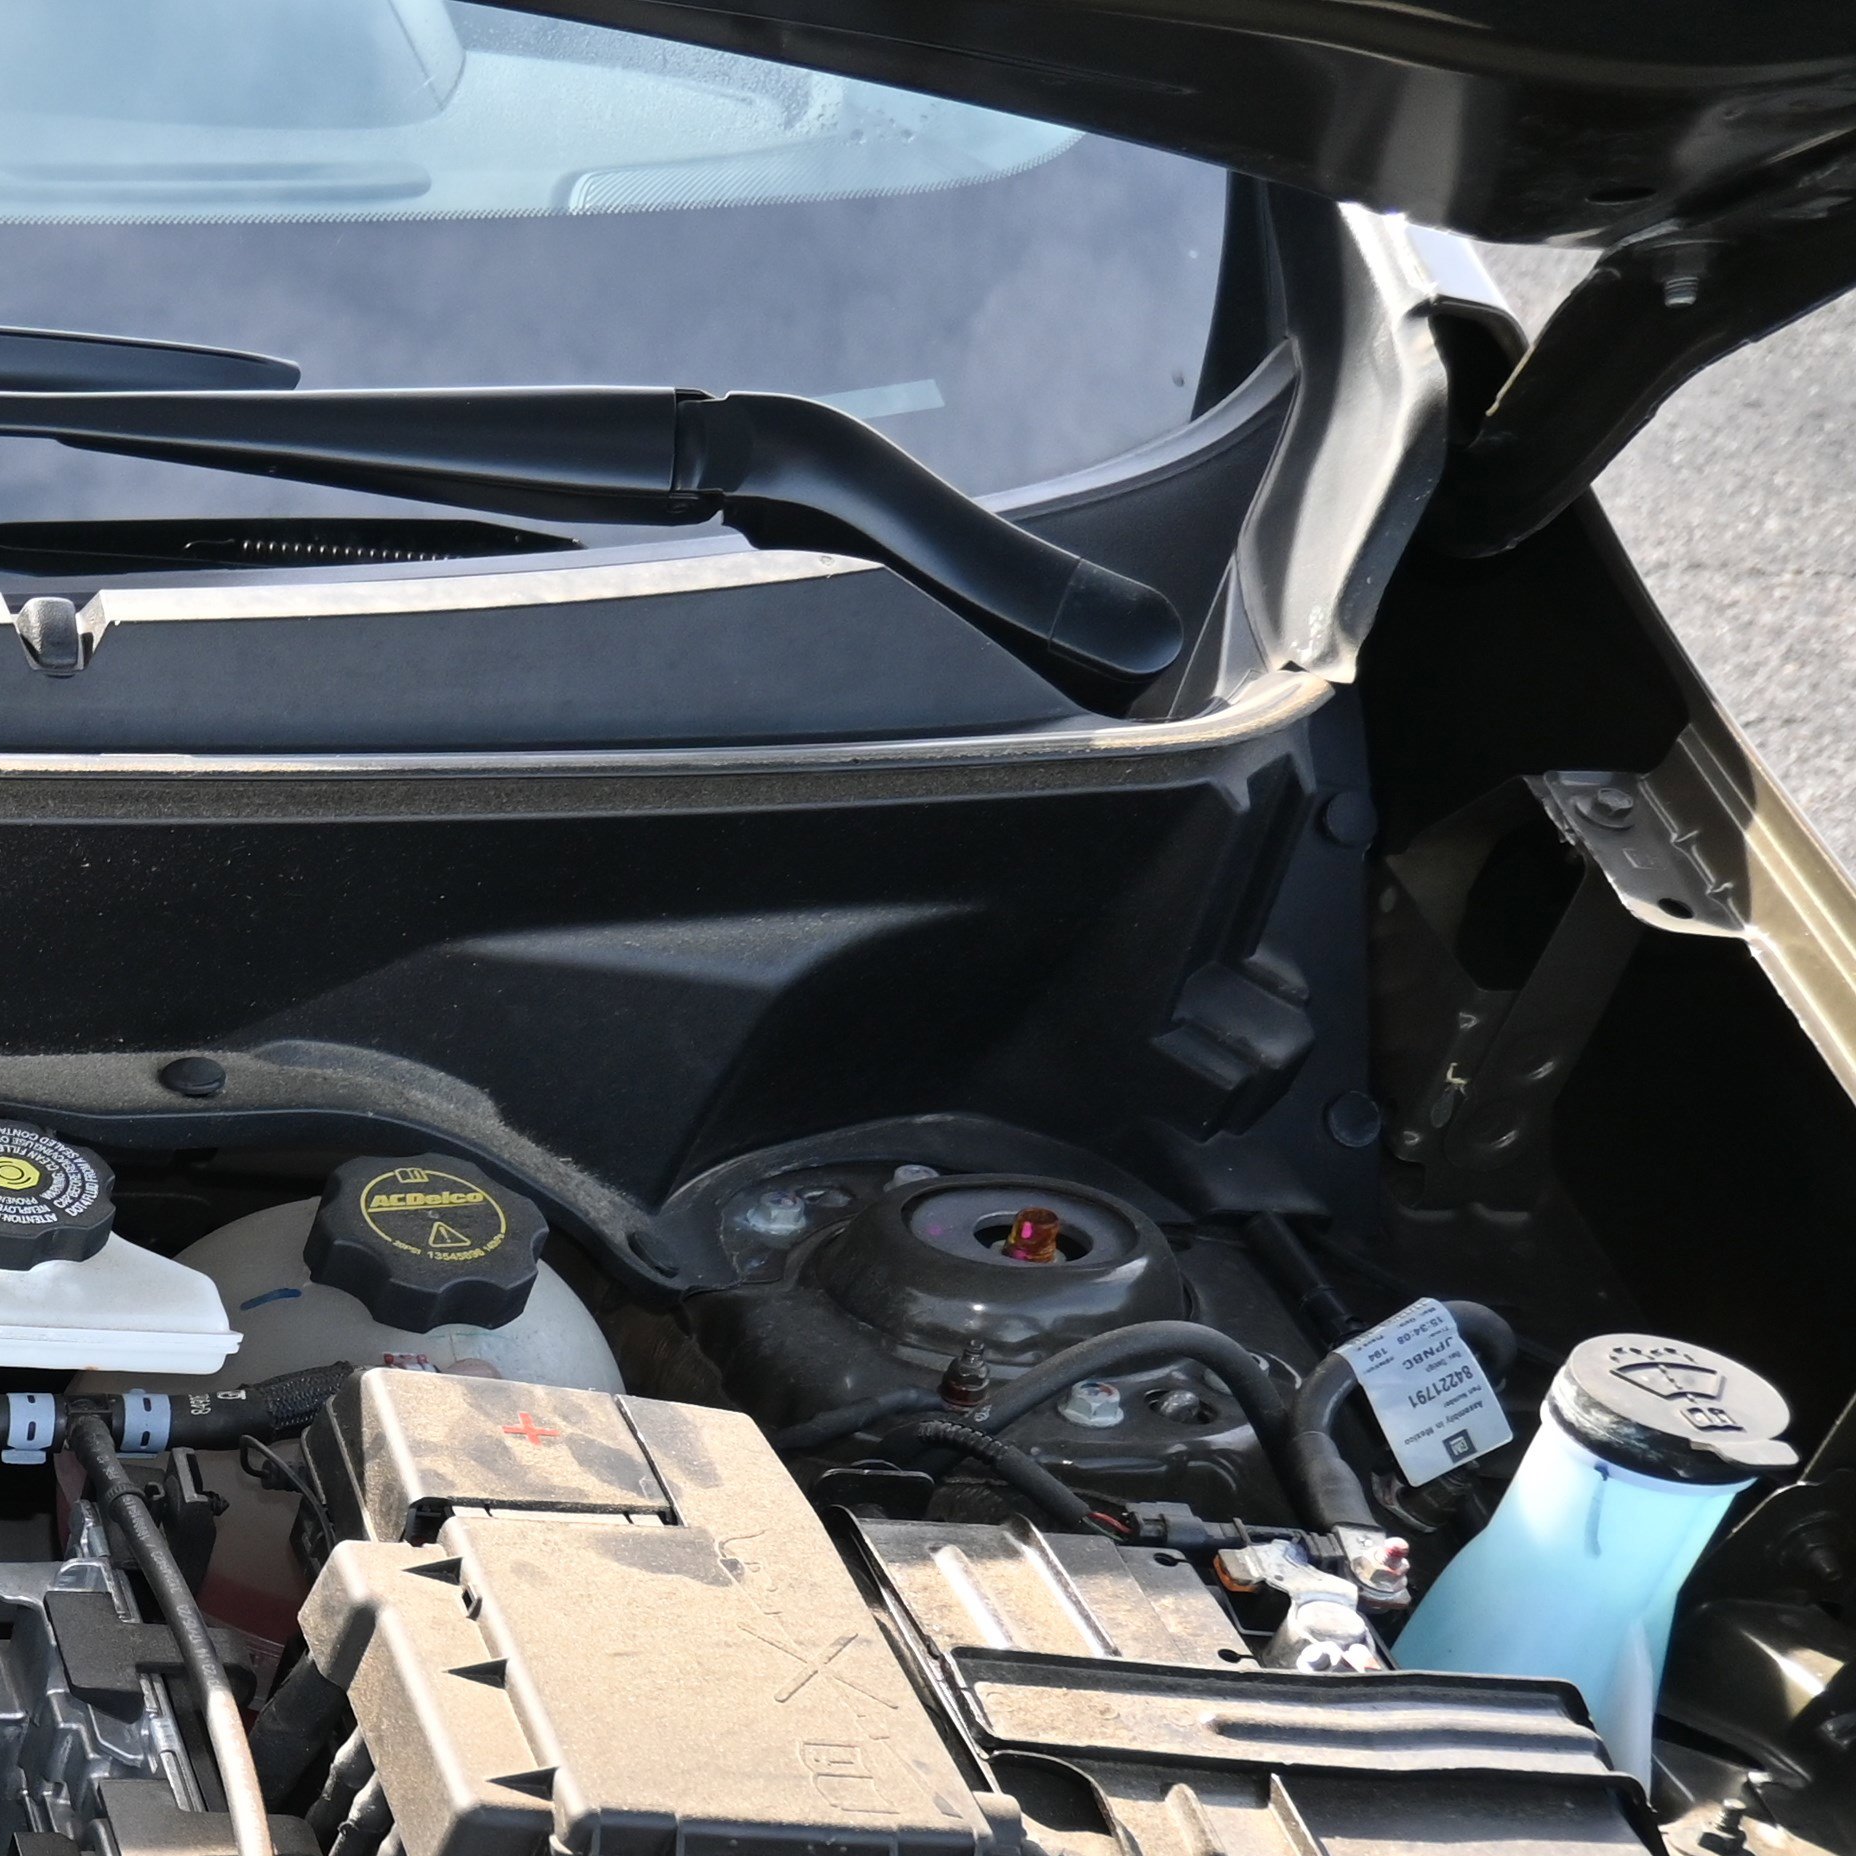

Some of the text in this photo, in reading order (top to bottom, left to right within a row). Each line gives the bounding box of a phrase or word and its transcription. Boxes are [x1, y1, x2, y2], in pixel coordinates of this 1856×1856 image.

[38, 1135, 81, 1158] SEALED
[27, 1150, 61, 1169] CLEAN
[370, 1191, 484, 1208] ACDelco
[1407, 1365, 1472, 1408] 84221791
[1404, 1399, 1482, 1446] Assembly in Mexico
[1451, 1439, 1468, 1454] GM
